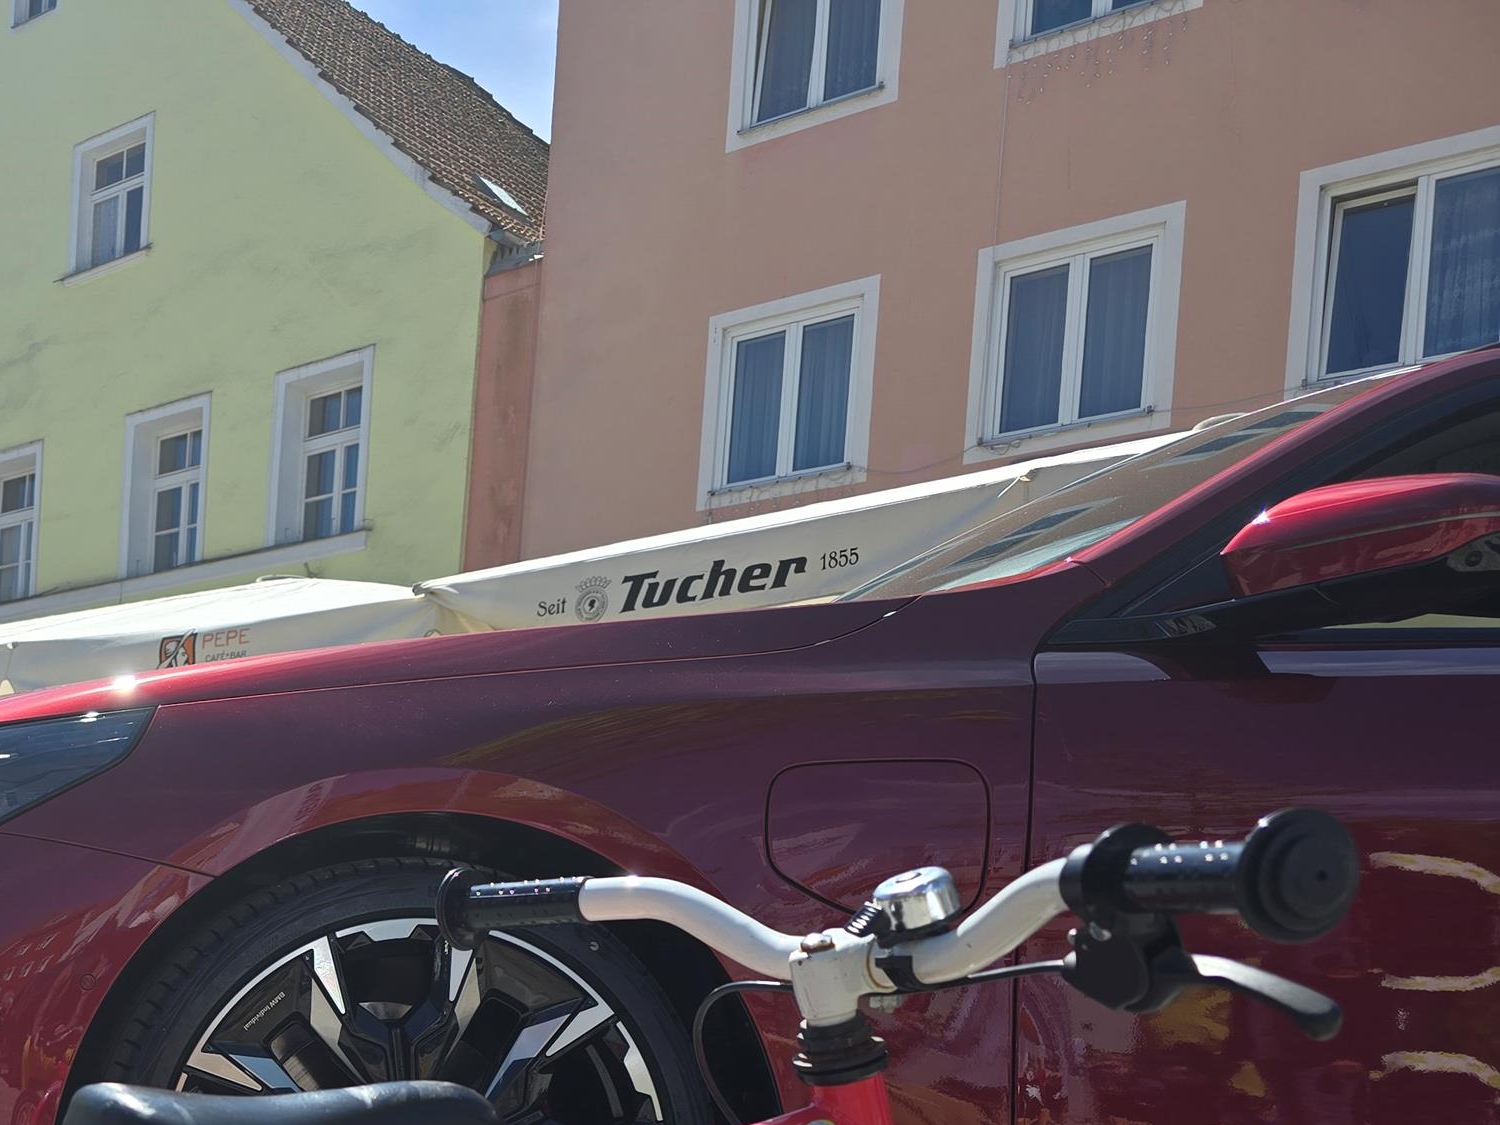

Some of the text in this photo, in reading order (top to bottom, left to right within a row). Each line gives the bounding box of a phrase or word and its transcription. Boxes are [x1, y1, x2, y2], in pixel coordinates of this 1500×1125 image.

[537, 597, 567, 617] Seit
[619, 556, 808, 614] Tucher
[819, 547, 860, 571] 1855
[202, 628, 251, 649] PEPE
